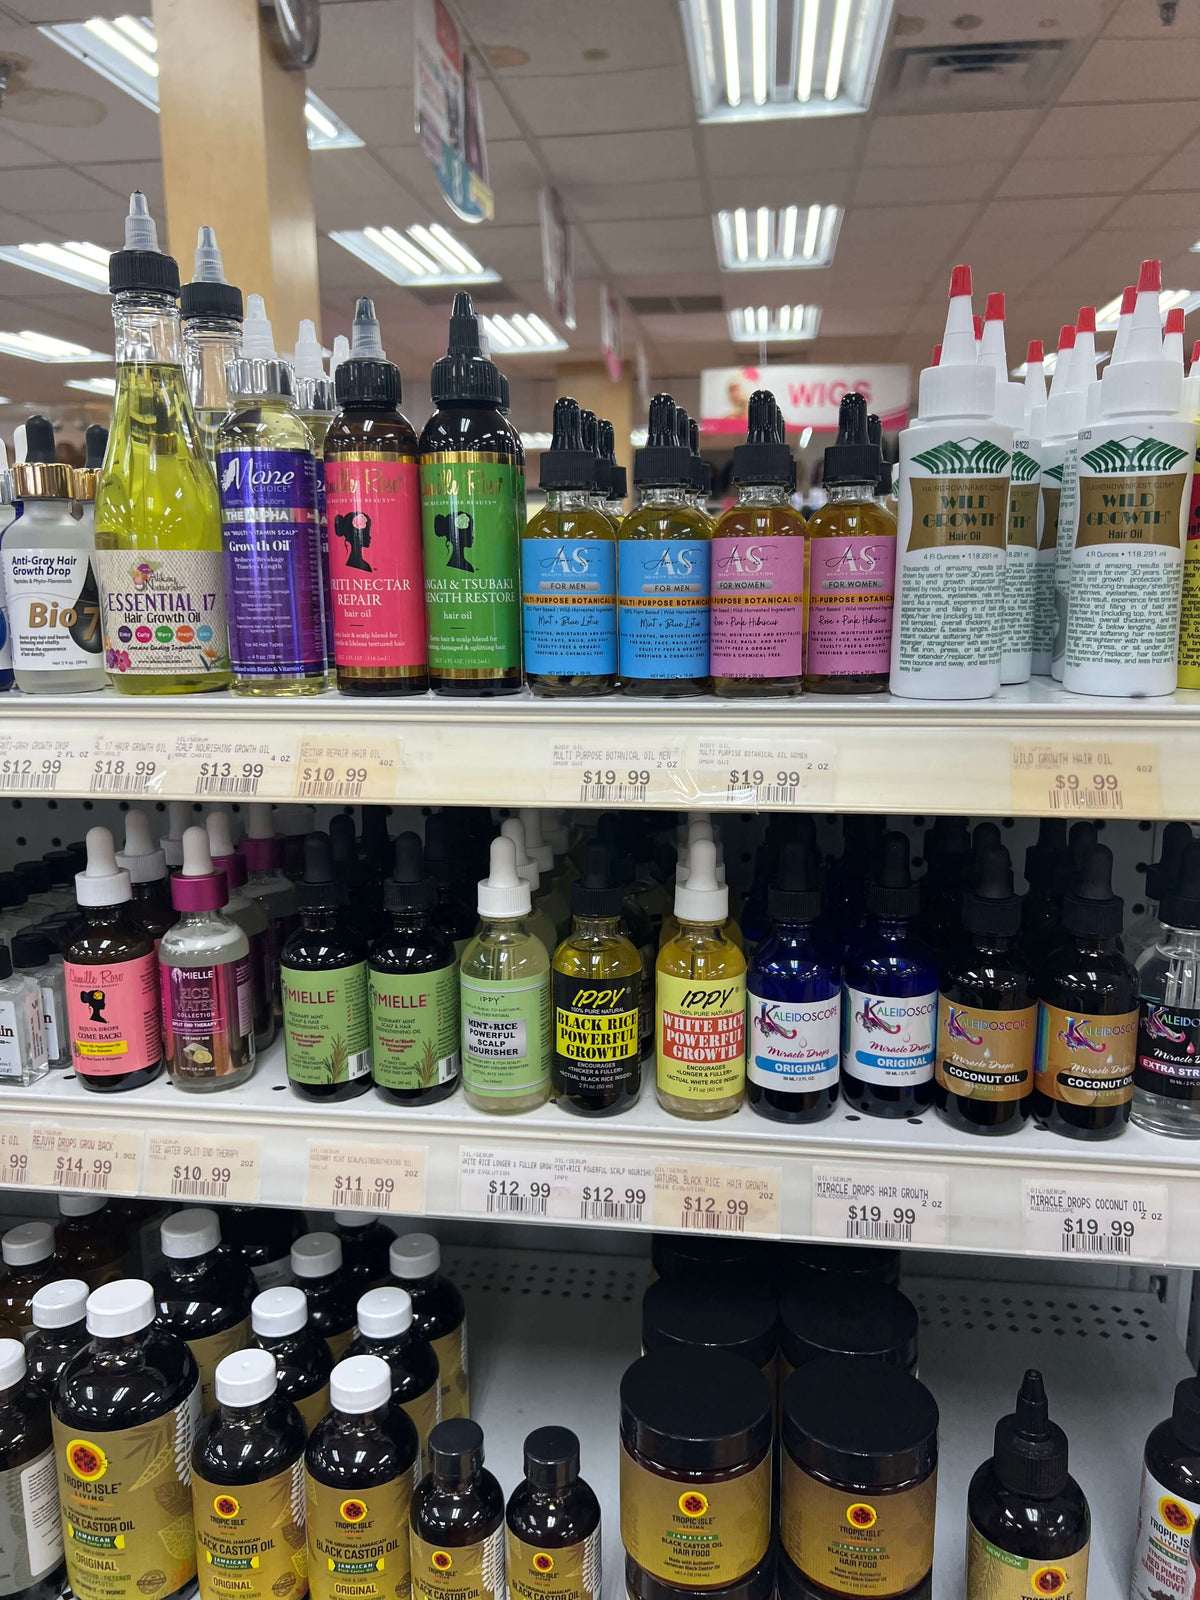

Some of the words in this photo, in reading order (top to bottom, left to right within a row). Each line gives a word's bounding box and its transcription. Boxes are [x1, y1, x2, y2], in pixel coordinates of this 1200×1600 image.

[788, 381, 872, 408] WIGS
[255, 462, 271, 470] THE
[222, 457, 295, 494] Mane
[365, 469, 399, 495] Rose
[253, 485, 288, 493] CHOICE
[940, 495, 990, 509] WILD
[1102, 493, 1154, 508] WILD
[225, 511, 244, 521] THE
[248, 510, 289, 521] ALPHA
[922, 512, 998, 528] GROWTH
[1086, 510, 1168, 526] GROWTH
[949, 531, 967, 541] Hair
[970, 531, 981, 541] Oil
[1108, 529, 1128, 540] Hair
[1130, 529, 1144, 540] Oil
[229, 540, 271, 552] Growth
[273, 540, 291, 552] Oil
[12, 555, 55, 566] Anti-Gray
[57, 556, 77, 566] Hair
[13, 566, 45, 576] Growth
[46, 566, 71, 577] Drop
[353, 579, 411, 591] NECTAR
[449, 579, 459, 589] &
[461, 578, 513, 590] TSUBAKI
[550, 582, 566, 590] FOR
[566, 582, 586, 590] MEN
[654, 585, 673, 593] FOR
[735, 581, 766, 589] WOMEN
[108, 593, 196, 613] ESSENTIAL
[203, 594, 216, 612] 17
[338, 594, 382, 606] REPAIR
[466, 592, 515, 603] RESTORE
[571, 597, 610, 606] BOTANICAL
[745, 597, 792, 605] BOTANICAL
[124, 613, 142, 624] Hair
[146, 612, 185, 625] Growth
[188, 612, 201, 623] Oil
[344, 609, 359, 617] hair
[360, 609, 372, 617] oil
[444, 611, 459, 619] hair
[461, 611, 472, 619] oil
[28, 602, 77, 628] Bio
[83, 605, 100, 641] 7
[2, 759, 62, 774] $12.99
[1097, 756, 1112, 765] OIL
[94, 760, 156, 776] $18.99
[200, 763, 264, 778] $13.99
[303, 768, 368, 783] $10.99
[583, 770, 650, 786] $19.99
[729, 770, 801, 787] $19.99
[101, 969, 124, 982] Rose
[182, 970, 214, 979] MIELLE
[180, 988, 210, 999] RICE
[288, 989, 336, 1005] MIELLE
[572, 988, 625, 1008] IPPY
[680, 989, 734, 1009] IPPY
[176, 1001, 216, 1012] WATER
[378, 994, 428, 1010] MIELLE
[479, 996, 500, 1006] IPPY
[468, 1018, 518, 1031] MINT+RICE
[558, 1012, 602, 1031] BLACK
[608, 1012, 638, 1031] RICE
[663, 1013, 713, 1033] WHITE
[717, 1012, 744, 1031] RICE
[97, 1032, 122, 1040] BACK!
[469, 1029, 516, 1039] POWERFUL
[561, 1027, 636, 1046] POWERFUL
[666, 1028, 742, 1048] POWERFUL
[469, 1045, 519, 1056] NOURISHER
[477, 1039, 506, 1048] SCALP
[567, 1043, 629, 1059] GROWTH
[672, 1046, 737, 1061] GROWTH
[775, 1063, 827, 1073] ORIGINAL
[877, 1056, 928, 1068] ORIGINAL
[1142, 1059, 1175, 1075] EXTRA
[950, 1066, 1002, 1084] COCONUT
[1004, 1073, 1020, 1083] OIL
[1067, 1077, 1122, 1091] COCONUT
[57, 1137, 76, 1149] DROPS
[79, 1139, 95, 1150] GROW
[98, 1141, 113, 1151] BACK
[56, 1157, 113, 1174] $14.99
[173, 1165, 232, 1183] $10.99
[334, 1176, 395, 1193] $11.99
[489, 1179, 551, 1199] $12.99
[683, 1174, 702, 1185] BLACK
[745, 1179, 769, 1190] GROWTH
[582, 1186, 646, 1205] $12.99
[758, 1192, 774, 1201] 2OZ
[817, 1182, 849, 1195] MIRACLE
[852, 1185, 875, 1197] DROPS
[878, 1187, 898, 1198] HAIR
[901, 1188, 929, 1200] GROWTH
[683, 1196, 749, 1216] $12.99
[932, 1201, 943, 1209] OZ
[1030, 1194, 1063, 1208] MIRACLE
[1067, 1196, 1091, 1209] DROPS
[1095, 1198, 1129, 1212] COCONUT
[1132, 1201, 1148, 1212] OIL
[848, 1204, 916, 1225] $19.99
[1151, 1213, 1163, 1221] OZ
[1063, 1217, 1136, 1238] $19.99
[63, 1472, 93, 1495] TROPIC
[95, 1481, 119, 1496] ISLE
[81, 1519, 118, 1533] CASTOR
[119, 1520, 136, 1532] OIL
[210, 1515, 229, 1526] TROPIC
[335, 1521, 354, 1529] TROPIC
[672, 1514, 697, 1525] TROPIC
[698, 1517, 713, 1525] ISLE
[839, 1525, 865, 1536] TROPIC
[866, 1529, 882, 1537] ISLE
[1150, 1515, 1179, 1544] TROPIC
[218, 1543, 259, 1556] CASTOR
[260, 1539, 276, 1552] OIL
[316, 1539, 343, 1559] BLACK
[343, 1548, 385, 1561] CASTOR
[386, 1540, 400, 1553] OIL
[661, 1537, 682, 1549] BLACK
[673, 1548, 690, 1558] HAIR
[691, 1549, 711, 1558] FOOD
[985, 1544, 1002, 1557] NEW
[1003, 1555, 1022, 1569] LOOK
[75, 1552, 118, 1571] ORIGINAL
[839, 1558, 856, 1567] HAIR
[858, 1560, 878, 1569] FOOD
[213, 1577, 252, 1590] ORIGINAL
[335, 1583, 377, 1596] ORIGINAL
